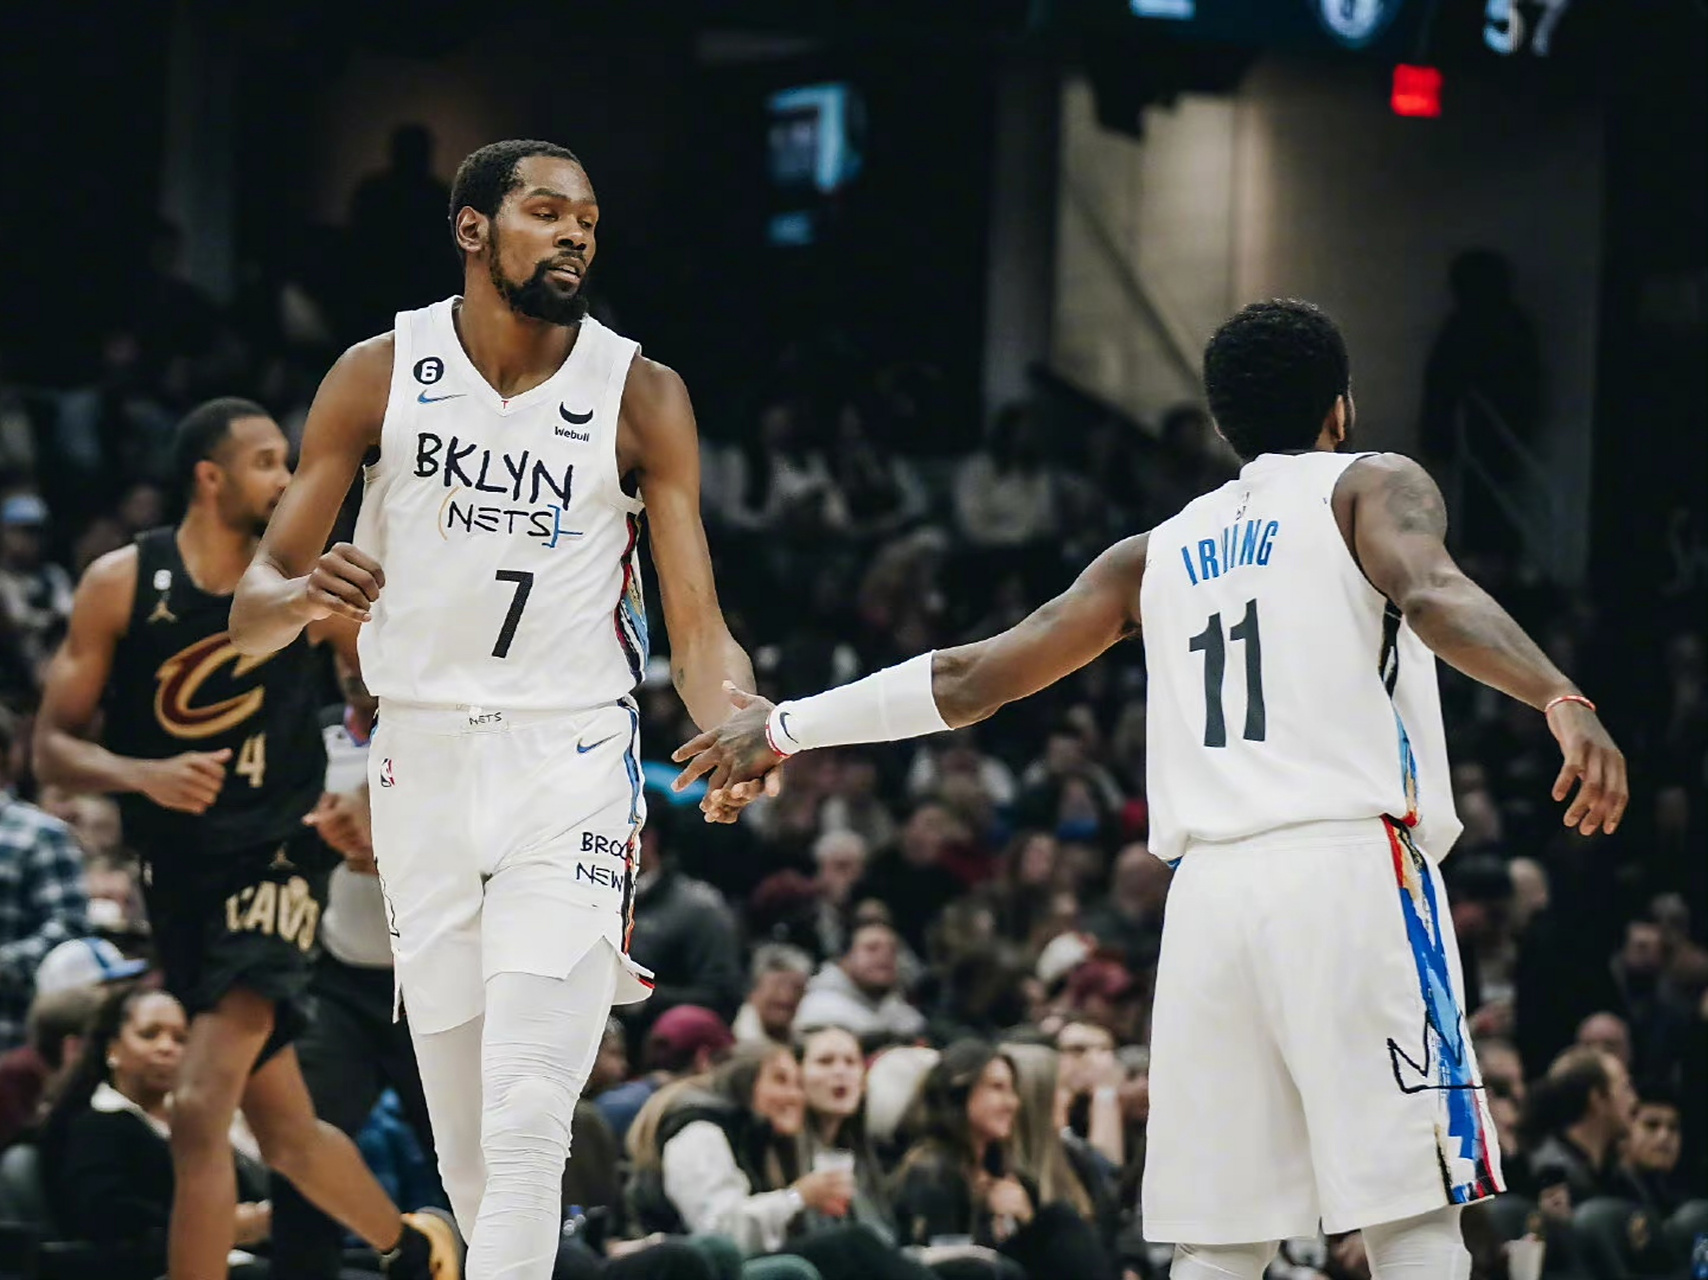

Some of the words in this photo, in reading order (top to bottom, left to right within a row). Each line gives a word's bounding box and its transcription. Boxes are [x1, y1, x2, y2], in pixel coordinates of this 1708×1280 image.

[420, 360, 438, 382] 6
[554, 426, 590, 442] Webull
[414, 432, 573, 511] BKLYN
[1181, 519, 1278, 586] IRVING
[491, 569, 534, 658] 7
[1189, 598, 1265, 748] 11
[469, 711, 502, 725] NETS
[236, 733, 267, 788] 4
[576, 862, 624, 892] NEW
